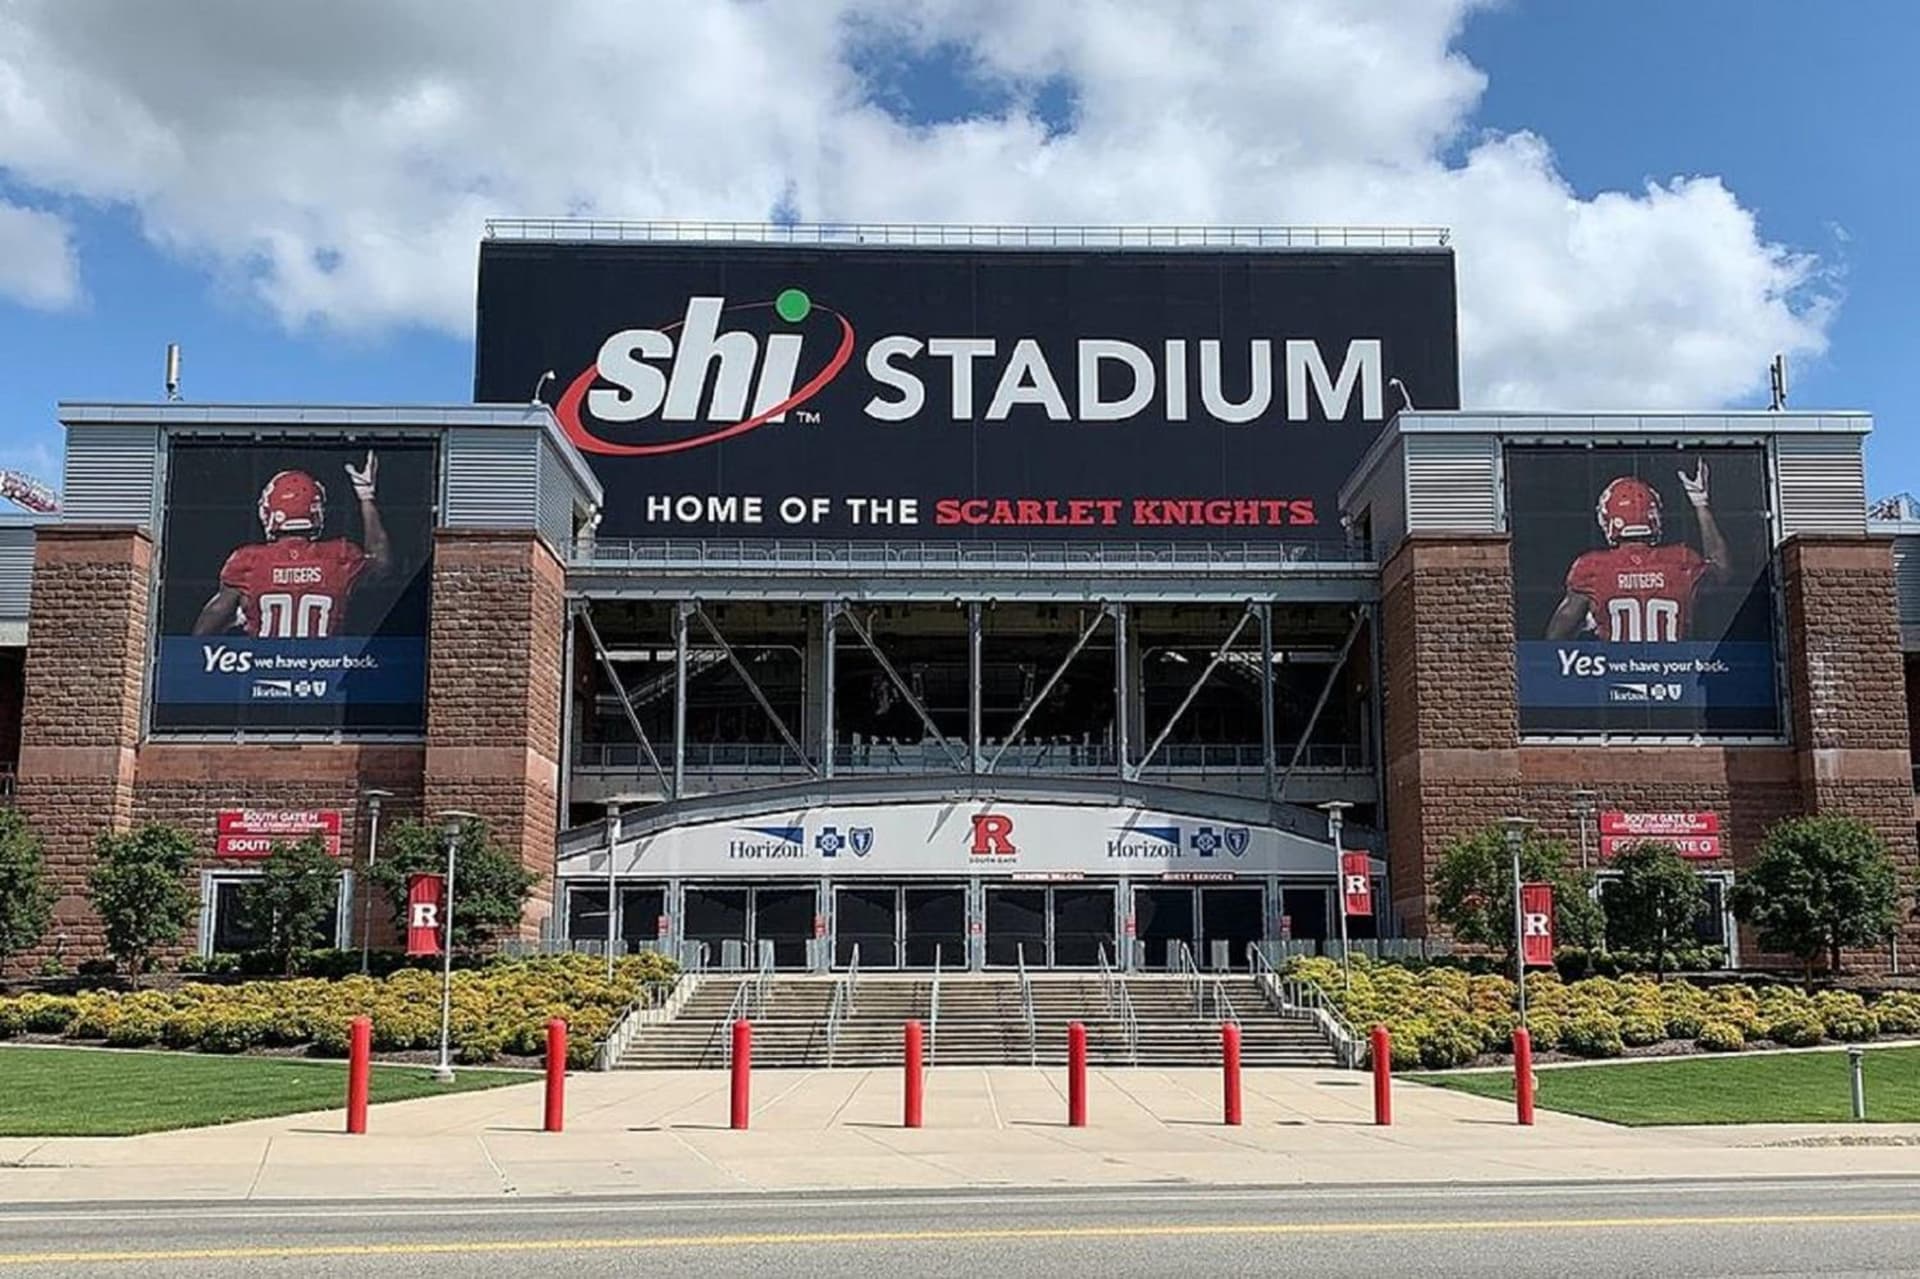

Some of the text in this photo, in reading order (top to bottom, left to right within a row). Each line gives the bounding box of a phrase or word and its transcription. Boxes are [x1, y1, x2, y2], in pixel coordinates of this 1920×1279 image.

[587, 289, 811, 423] shi
[863, 335, 1384, 423] STADIUM
[647, 495, 763, 523] HOME
[780, 496, 830, 524] OF
[846, 498, 919, 525] THE
[935, 499, 1122, 525] SCARLET
[272, 567, 322, 584] RUTGERS
[1618, 571, 1665, 589] RUTGERS
[203, 645, 253, 673] Yes
[254, 658, 274, 669] we
[275, 654, 308, 669] have
[309, 658, 341, 672] your
[1557, 648, 1607, 676] Yes
[1609, 662, 1628, 673] we
[1629, 658, 1661, 673] have
[1662, 662, 1693, 676] your
[971, 814, 1017, 855] R
[729, 840, 804, 859] Horizon
[1106, 840, 1182, 858] Horizon
[1346, 875, 1368, 894] R
[412, 903, 439, 928] R
[1524, 913, 1550, 936] R
